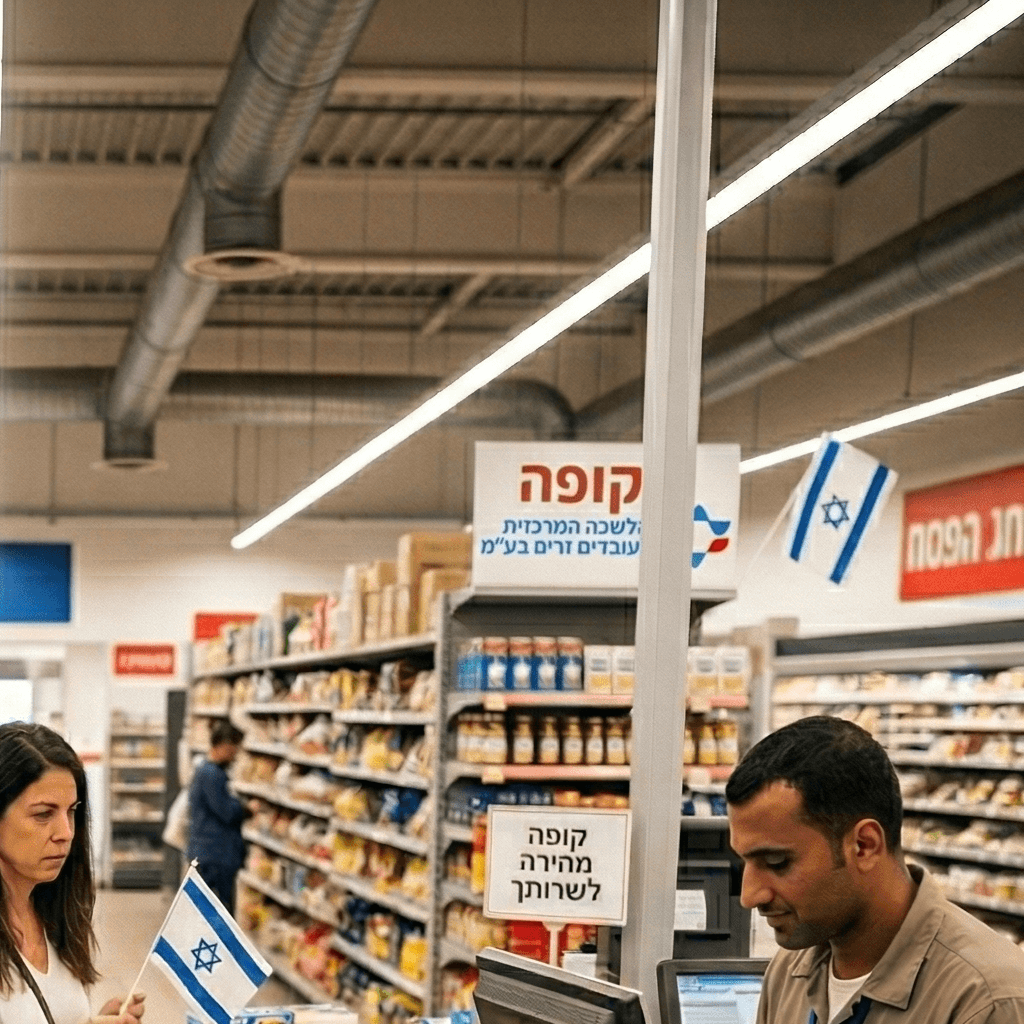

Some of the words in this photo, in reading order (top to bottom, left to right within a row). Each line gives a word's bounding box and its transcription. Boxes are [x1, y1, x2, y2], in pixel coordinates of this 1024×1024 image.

[520, 464, 643, 515] קופה
[502, 519, 581, 535] המרכזית
[534, 540, 573, 555] זרים
[907, 510, 982, 573] הפסח
[529, 827, 588, 852] קופה
[520, 853, 592, 873] מהירה
[511, 877, 602, 904] לשרותך
